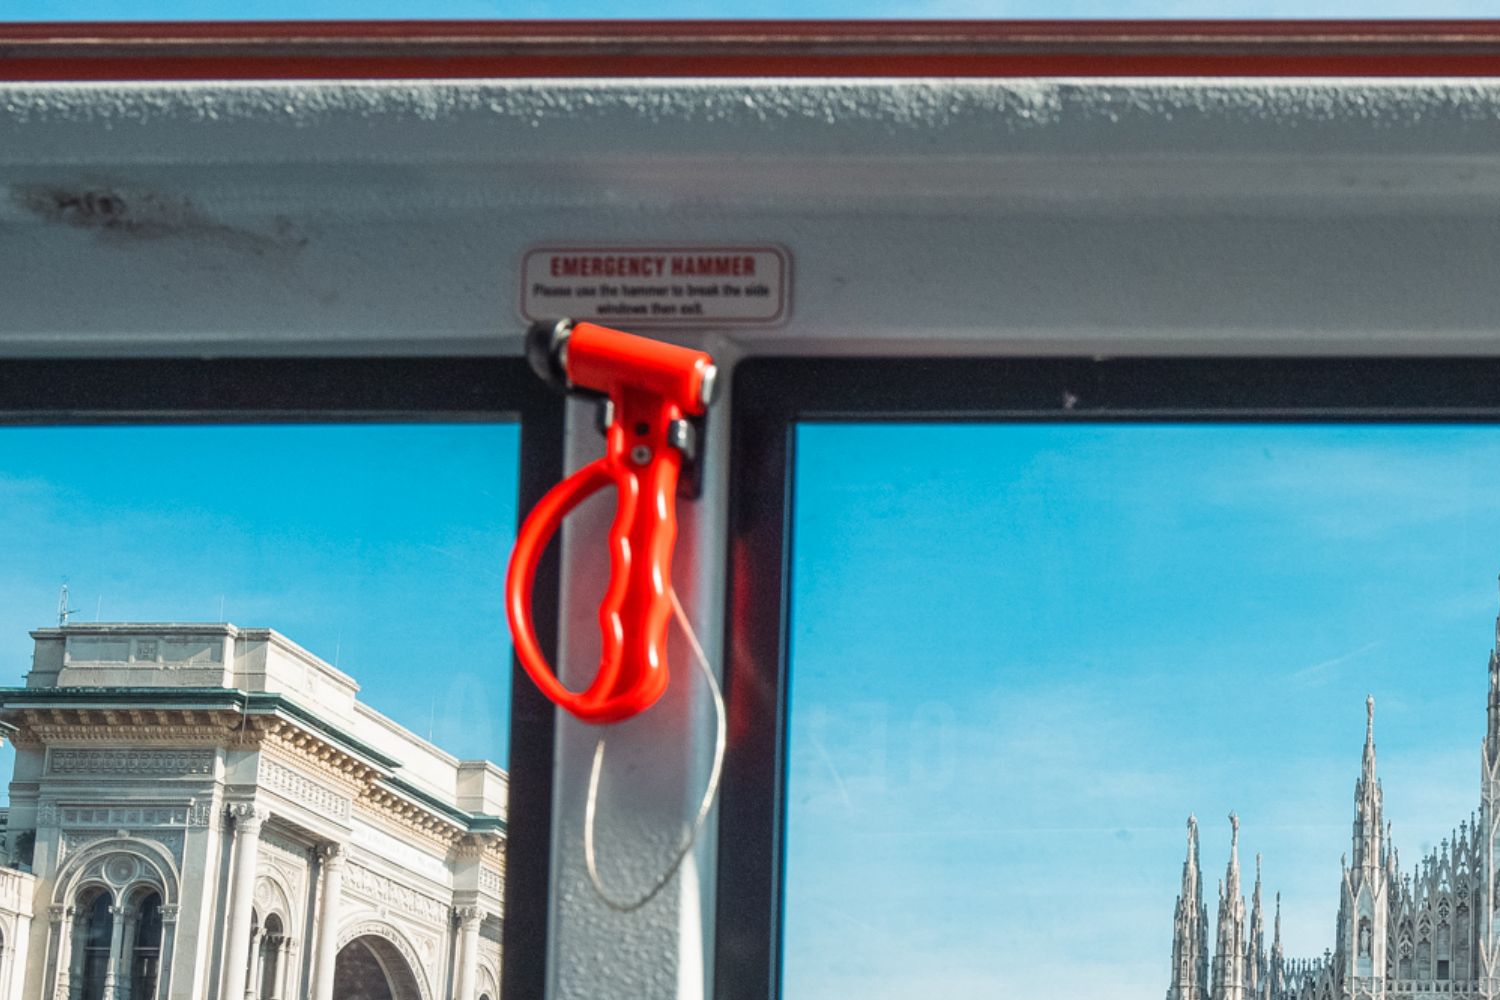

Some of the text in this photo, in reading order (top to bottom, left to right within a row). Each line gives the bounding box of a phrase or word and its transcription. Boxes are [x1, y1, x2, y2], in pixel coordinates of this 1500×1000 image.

[550, 256, 755, 277] EMERGENCY HAMMER
[533, 283, 769, 297] Please use the hammer to break the side
[596, 302, 647, 315] windows
[651, 302, 676, 315] then
